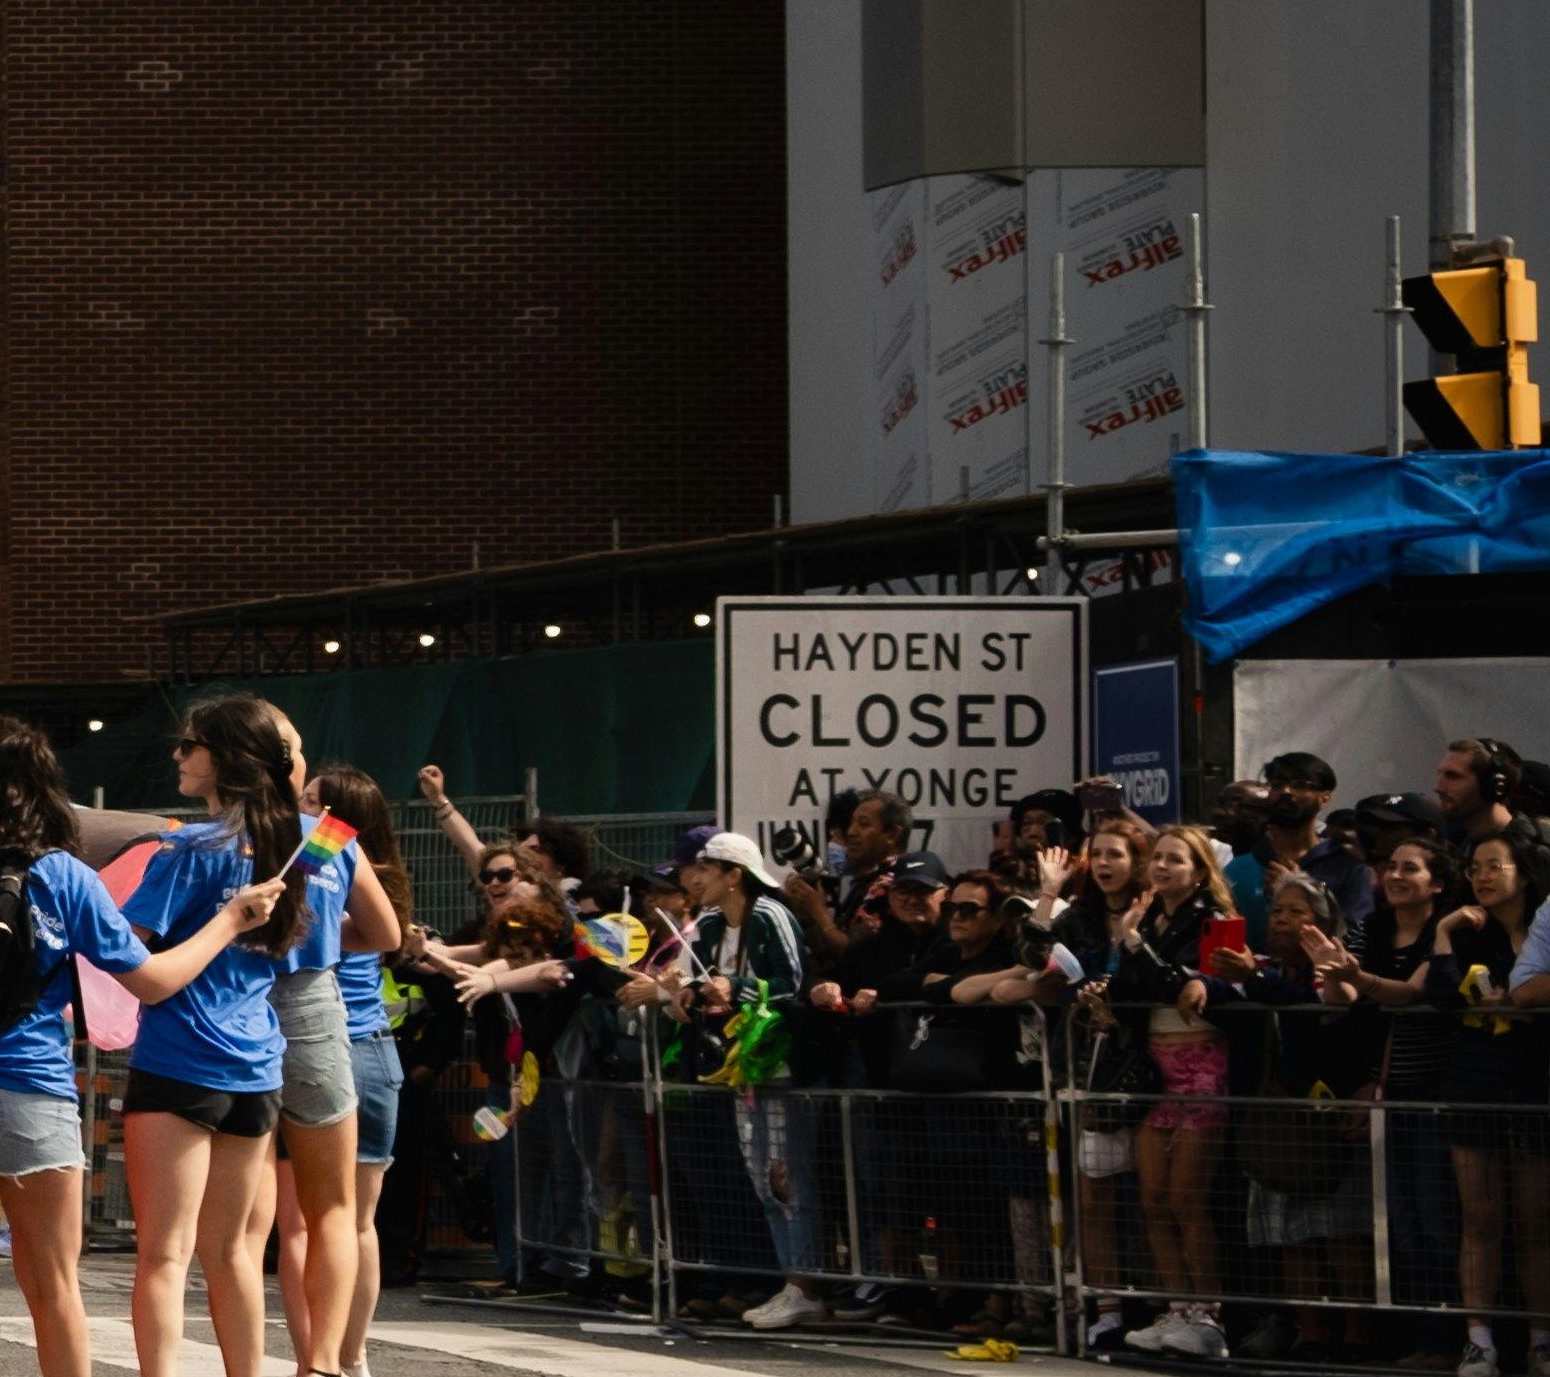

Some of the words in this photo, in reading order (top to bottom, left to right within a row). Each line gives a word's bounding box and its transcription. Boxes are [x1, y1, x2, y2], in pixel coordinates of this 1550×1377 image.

[1124, 220, 1176, 252] PLATE
[1085, 234, 1184, 288] alfrex
[1127, 372, 1177, 403] PLATE
[1085, 386, 1185, 440] alfrex
[773, 632, 960, 671] HAYDEN
[981, 632, 1031, 671] ST
[759, 693, 1047, 748] CLOSED
[789, 768, 843, 807] AT
[861, 768, 1019, 809] YONGE
[758, 820, 830, 866] JUN
